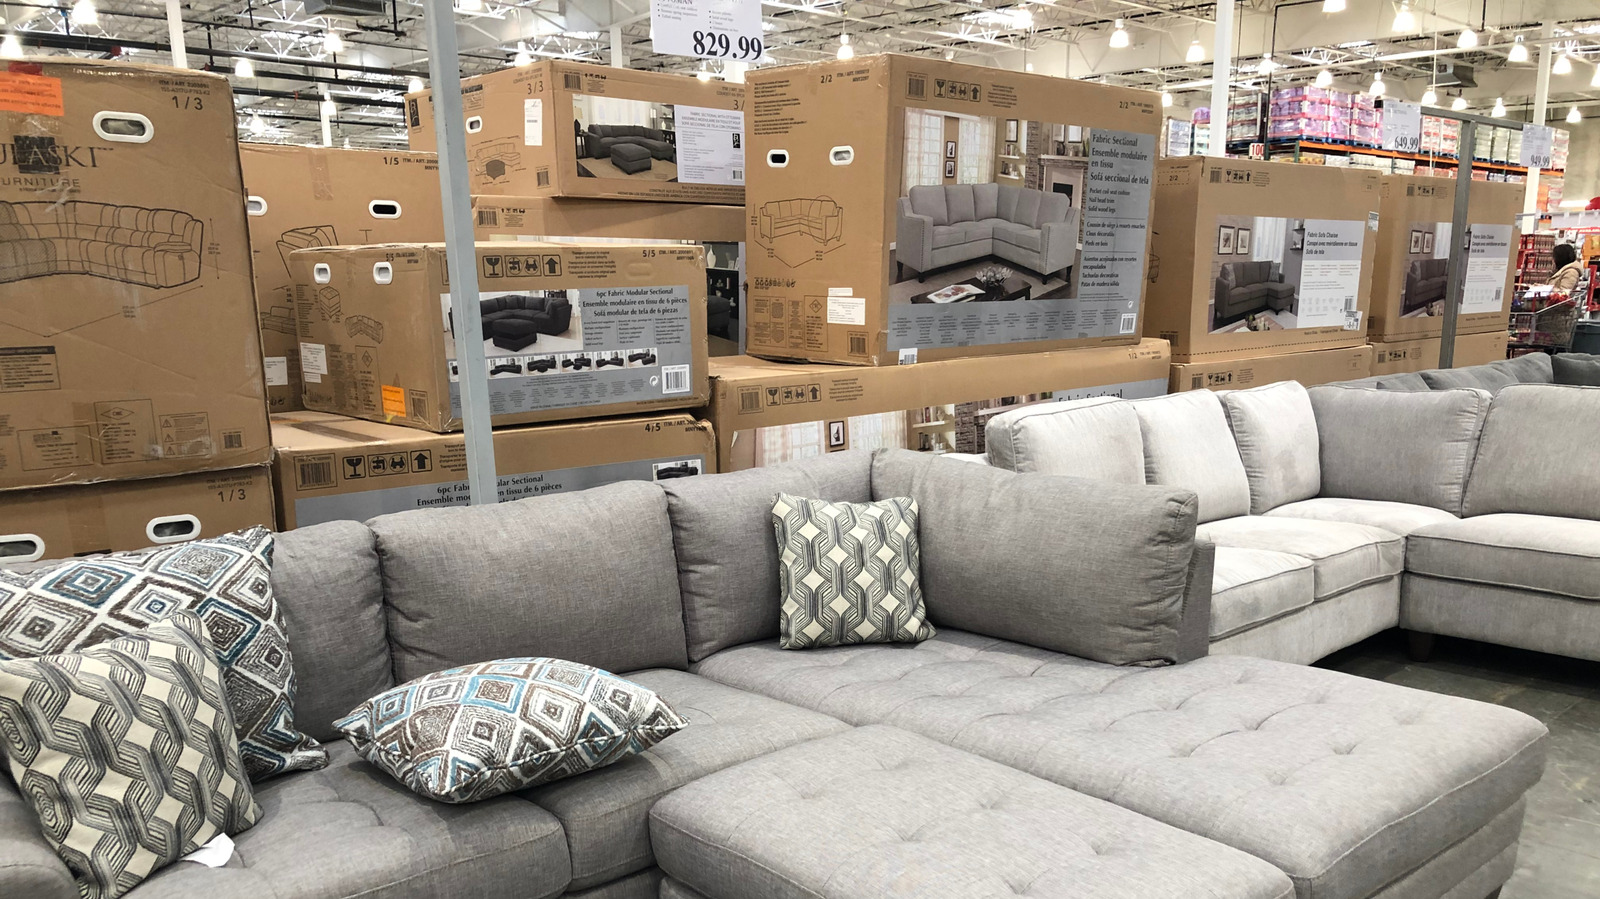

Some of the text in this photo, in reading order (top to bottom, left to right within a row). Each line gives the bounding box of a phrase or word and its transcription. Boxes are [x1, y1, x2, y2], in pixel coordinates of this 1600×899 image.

[693, 30, 762, 61] 829.99
[820, 74, 833, 84] 2/2
[527, 80, 544, 95] 3/3
[1119, 101, 1129, 109] 2/2
[1092, 134, 1138, 147] Fabric Sectional
[1394, 136, 1418, 150] 649.99
[1092, 148, 1148, 161] Ensemble modulaire
[384, 156, 400, 166] 1/5
[1100, 159, 1113, 168] tissu
[1531, 154, 1550, 167] 949.99
[2, 177, 80, 189] URNITURE
[1104, 174, 1130, 183] seccional
[1131, 175, 1138, 184] de
[1139, 176, 1148, 184] tela
[642, 250, 656, 258] 5/5
[596, 290, 606, 298] 6pc
[608, 288, 624, 296] Fabric
[671, 296, 688, 306] pièces
[607, 308, 630, 316] modular
[662, 307, 678, 316] piezas
[645, 422, 661, 432] 4/5
[437, 486, 452, 495] 6pc
[512, 475, 544, 486] Sectional
[541, 483, 562, 494] pièces
[417, 495, 454, 506] Ensemble
